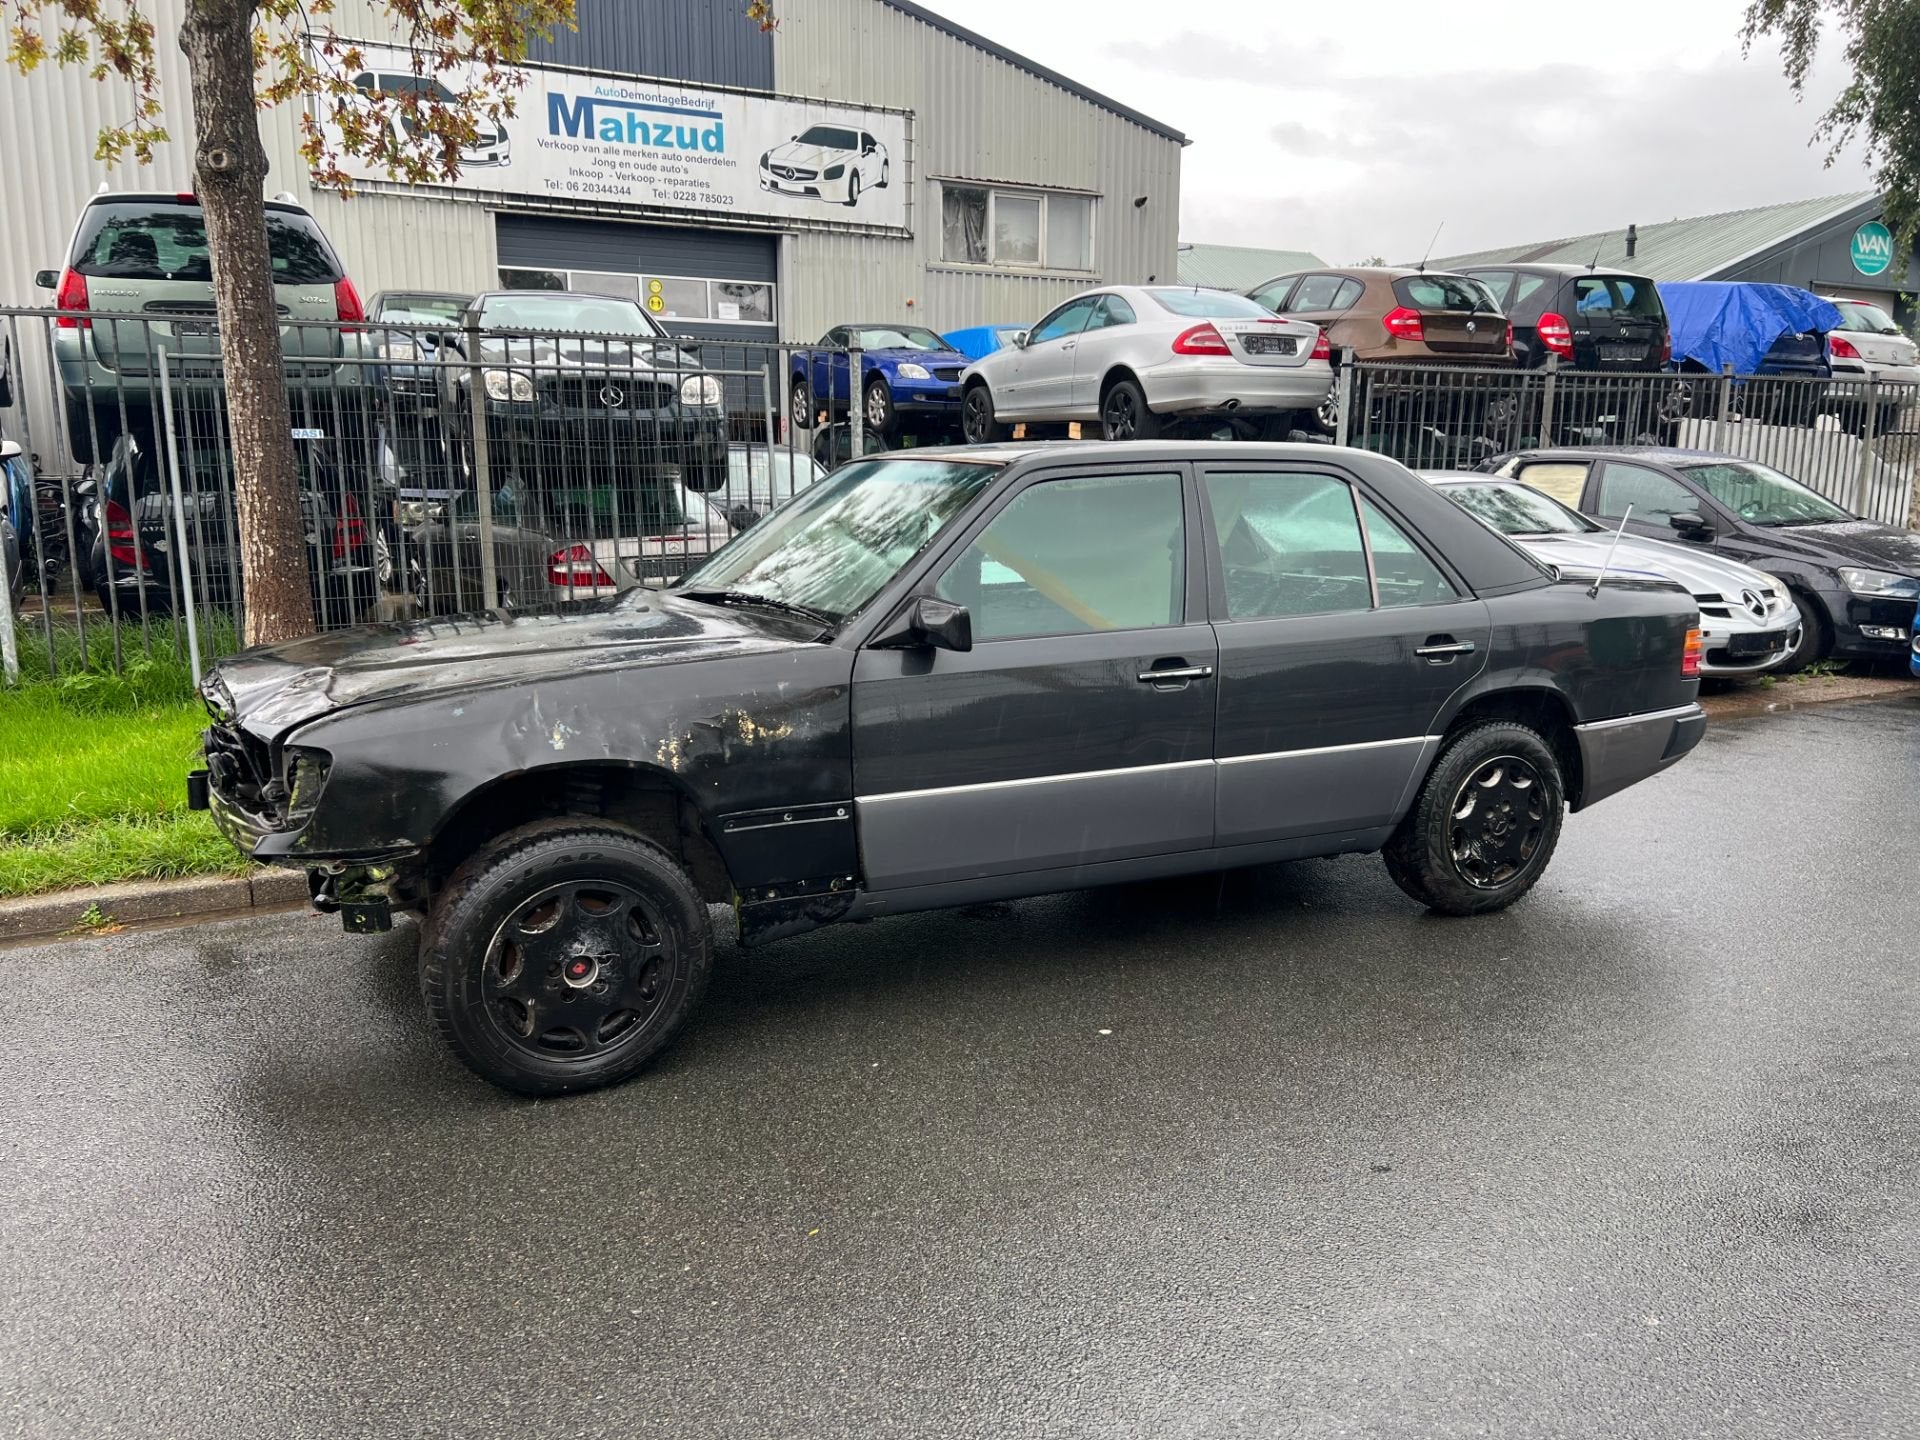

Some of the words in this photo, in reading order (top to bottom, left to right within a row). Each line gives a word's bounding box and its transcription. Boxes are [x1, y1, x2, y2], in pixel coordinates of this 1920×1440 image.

[594, 85, 715, 110] AutoDemontageBedrijf
[547, 92, 724, 153] Mahzud
[536, 138, 579, 152] Verkoop
[582, 145, 600, 154] van
[603, 146, 620, 155] alle
[623, 149, 659, 160] merken
[661, 152, 682, 162] auto
[685, 155, 737, 167] onderdelen
[592, 157, 616, 169] Jong
[619, 161, 631, 169] en
[633, 162, 657, 171] oude
[660, 164, 689, 174] auto's
[544, 179, 563, 190] Tel:
[566, 181, 579, 191] 06
[582, 182, 631, 195] 20344344
[569, 167, 604, 180] Inkoop
[615, 171, 655, 184] Verkoop
[663, 177, 711, 188] reparaties
[652, 189, 671, 199] Tel:
[673, 191, 697, 201] 0228
[699, 193, 734, 205] 785023
[1857, 233, 1889, 255] WAN
